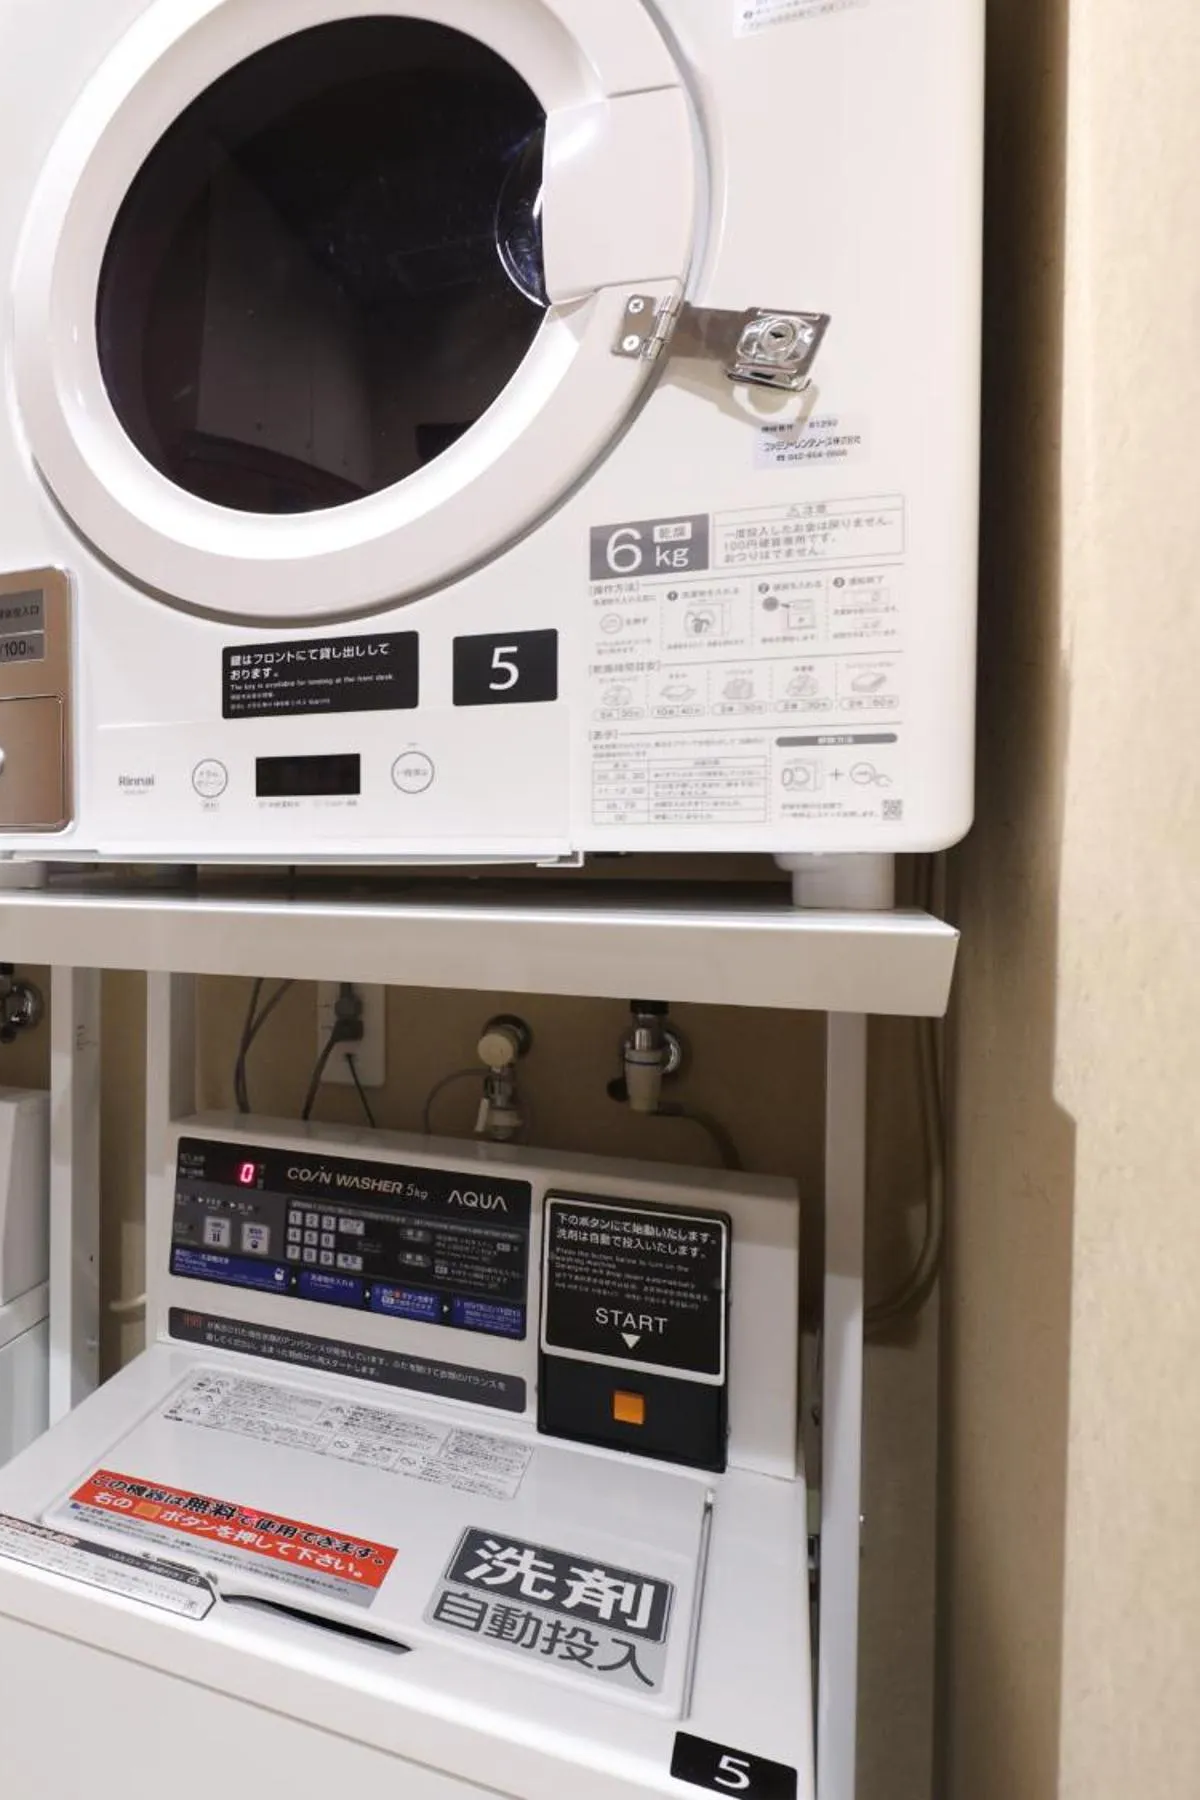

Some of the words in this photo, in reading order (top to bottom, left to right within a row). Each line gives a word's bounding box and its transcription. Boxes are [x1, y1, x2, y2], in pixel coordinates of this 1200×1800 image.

[606, 528, 642, 573] 6
[655, 547, 689, 568] kg
[230, 642, 390, 667] 鍵はフロントにて貸し出しして
[489, 645, 519, 691] 5
[230, 667, 279, 681] おります。
[118, 774, 155, 786] Rinnai
[239, 1162, 255, 1184] 0
[288, 1165, 333, 1185] COIN
[336, 1174, 403, 1194] WASHER
[406, 1183, 429, 1201] 5kg
[448, 1189, 509, 1213] AQUA
[556, 1227, 706, 1258] 洗剤は自動で投入いたします。
[557, 1211, 716, 1245] 下のボタンにて始動いたします。
[595, 1306, 668, 1335] START
[91, 1475, 385, 1566] この機器は無料で使用できます。
[94, 1491, 132, 1509] 右の
[158, 1509, 363, 1578] ボタンを押して下さい。
[463, 1538, 656, 1630] 洗剤
[432, 1590, 655, 1688] 自動投入
[713, 1754, 751, 1790] 5
